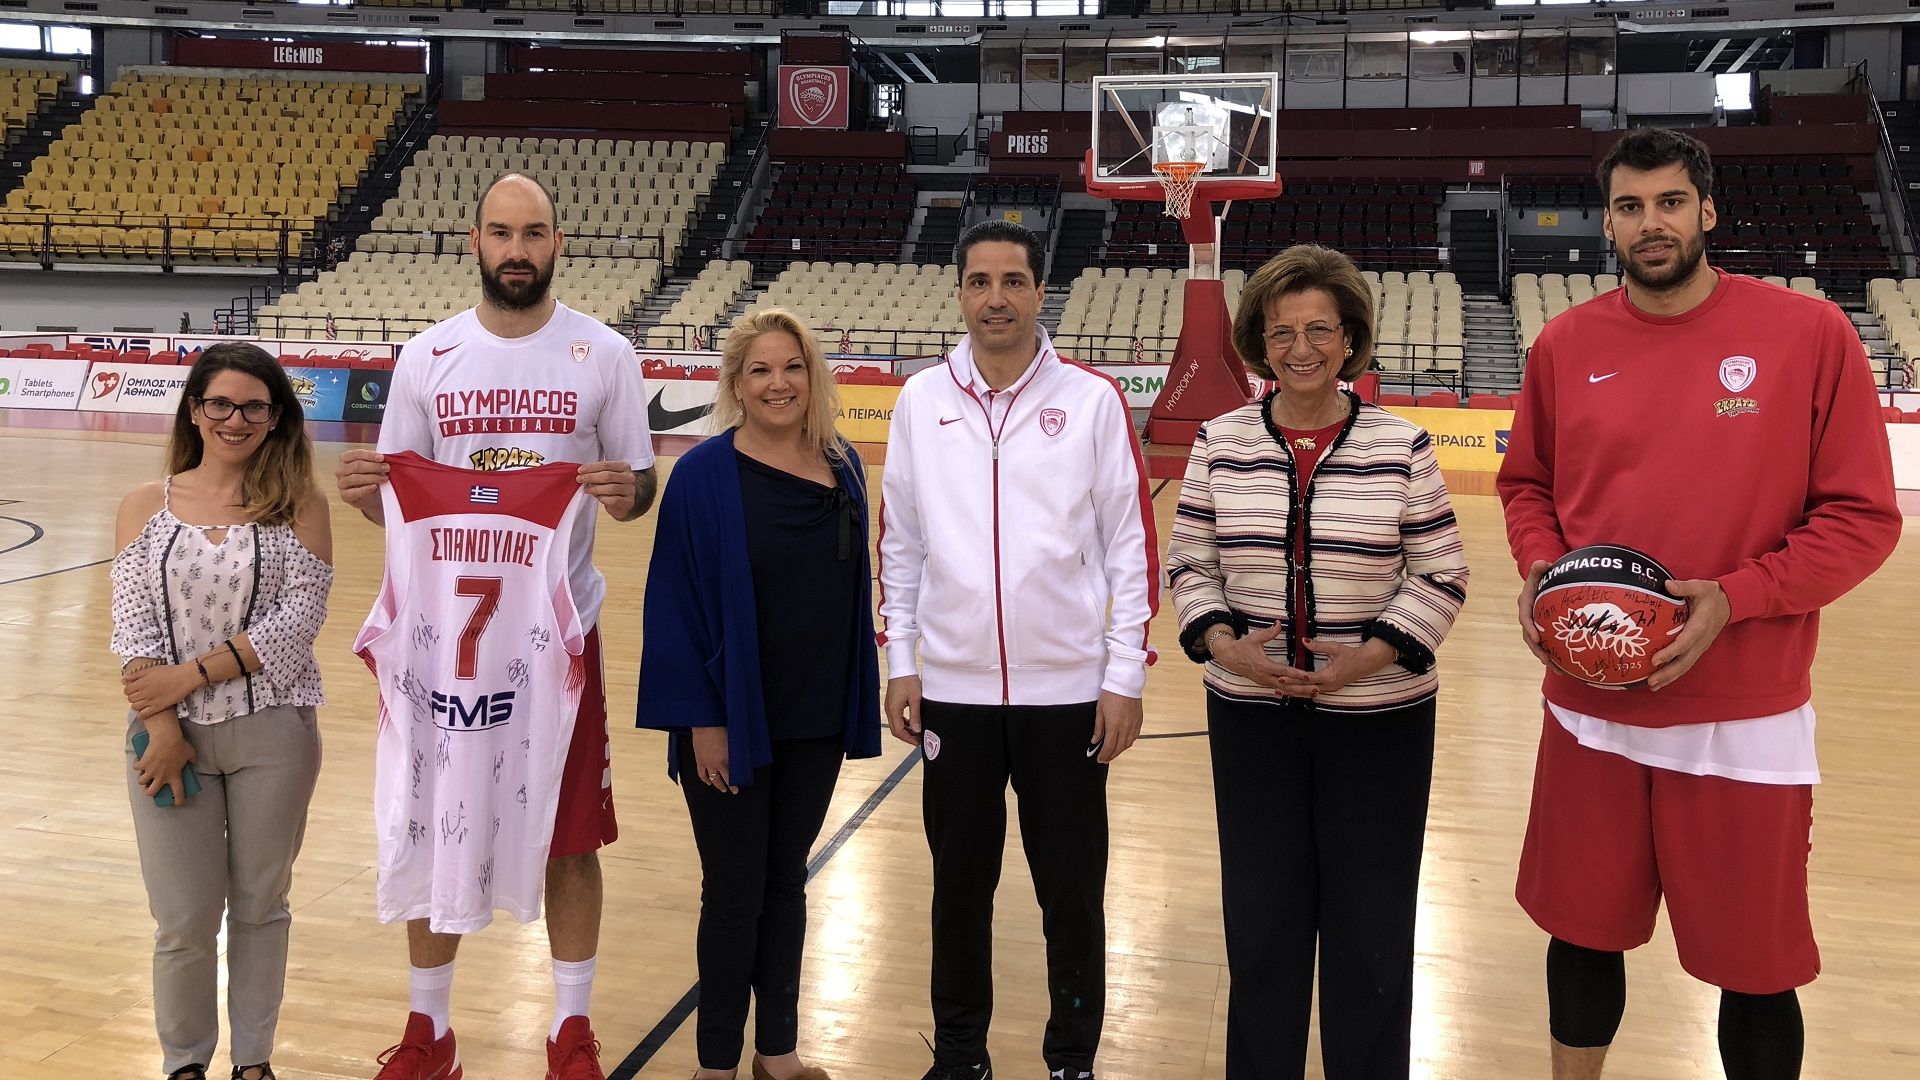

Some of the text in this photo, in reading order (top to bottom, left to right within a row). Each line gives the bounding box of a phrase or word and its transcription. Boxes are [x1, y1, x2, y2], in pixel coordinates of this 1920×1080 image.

[273, 46, 323, 64] LEGENDS
[795, 73, 832, 82] OLYMPIACOS
[1007, 135, 1048, 154] PRESS
[1470, 162, 1483, 174] VIP
[24, 378, 53, 388] Tablets
[123, 387, 167, 397] ΑΘΗΝΩΝ
[127, 378, 166, 388] ΟΜΙΛΟΣ
[1165, 359, 1200, 412] HYDROPLAY
[21, 388, 75, 398] Smartphones
[436, 389, 577, 419] OLYMPIACOS
[442, 418, 569, 436] BASKETBALL
[430, 528, 539, 568] ΣΠΑΝΟΥΛΗΣ
[1538, 557, 1658, 591] OLYMPIACOS B.C.
[455, 576, 503, 680] 7
[431, 690, 516, 728] FMS
